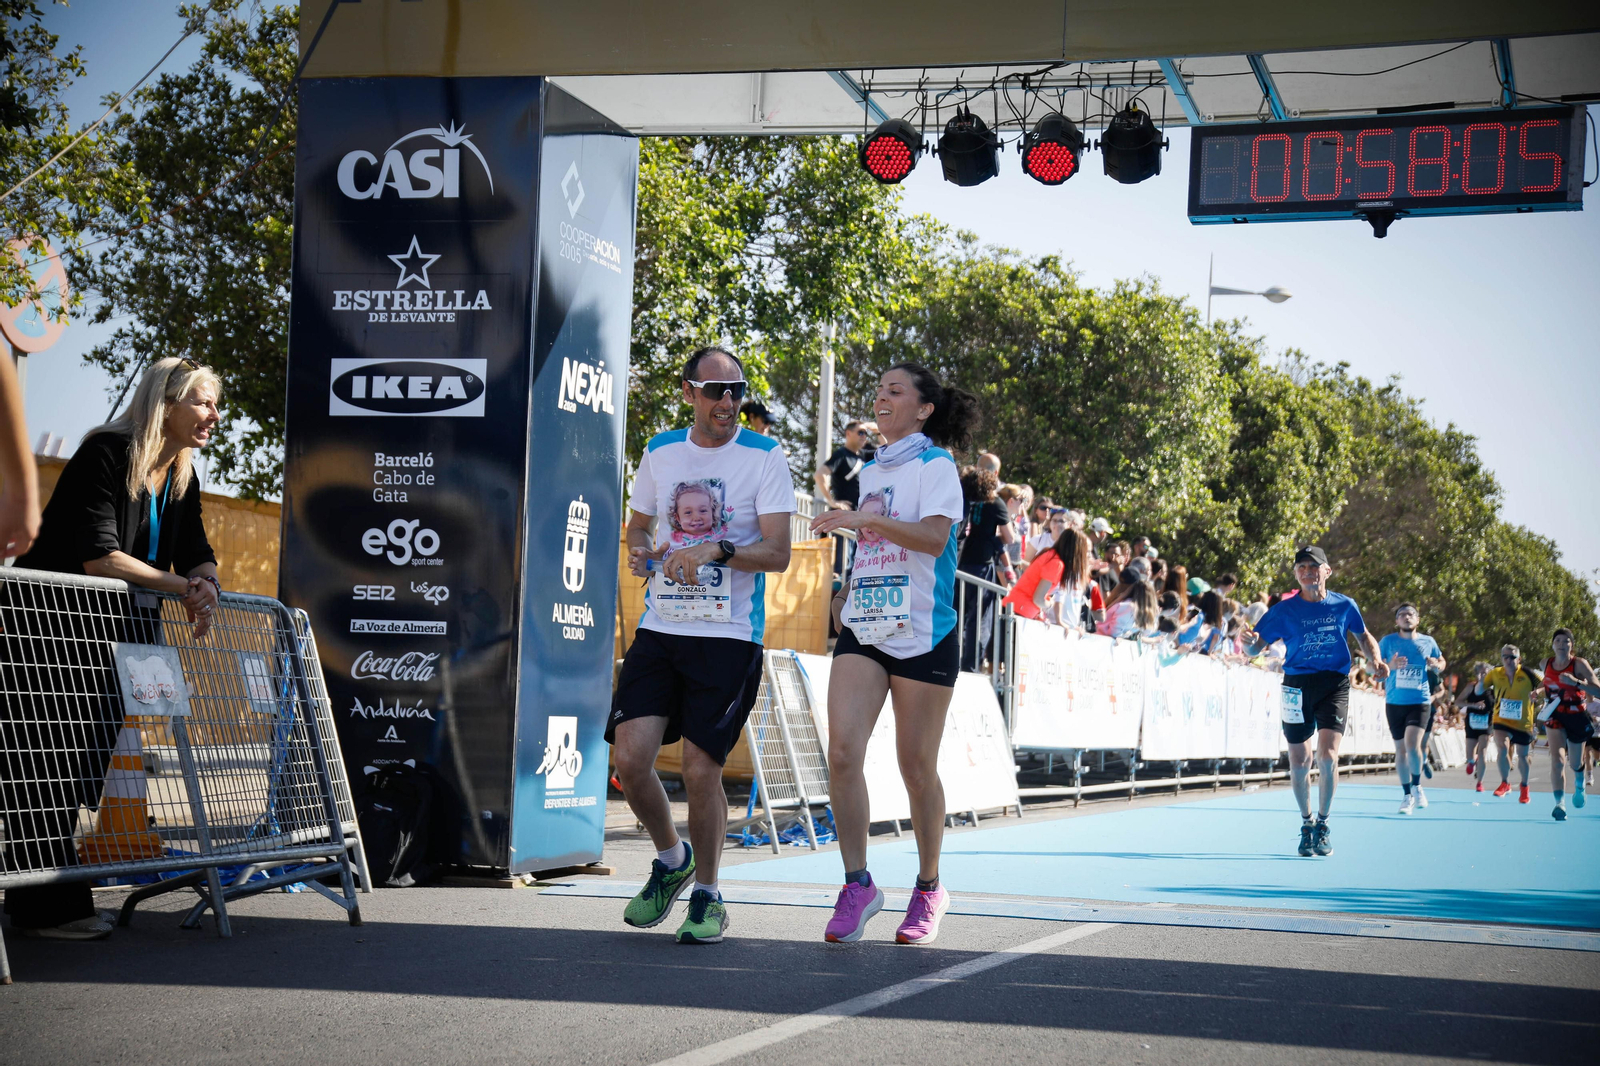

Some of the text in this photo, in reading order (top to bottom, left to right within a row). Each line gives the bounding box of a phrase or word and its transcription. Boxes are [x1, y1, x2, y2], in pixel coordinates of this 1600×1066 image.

[337, 149, 460, 200] CASI
[560, 221, 621, 264] COOPERACIÓN
[560, 240, 581, 264] 2005
[332, 289, 492, 311] ESTRELLA
[368, 312, 456, 323] DE LEVANTE
[352, 375, 468, 399] IKEA
[374, 452, 434, 468] Barceló
[373, 470, 435, 485] Cabo de
[372, 487, 408, 503] Gata
[361, 518, 441, 566] ego
[411, 557, 444, 567] sport center
[352, 585, 396, 600] SER
[854, 586, 904, 610] 5590
[552, 601, 595, 628] ALMERÍA
[351, 621, 445, 633] La Voz de Almería
[562, 625, 586, 641] CIUDAD
[350, 650, 441, 682] Coca-Cola
[349, 696, 437, 722] Andalucía
